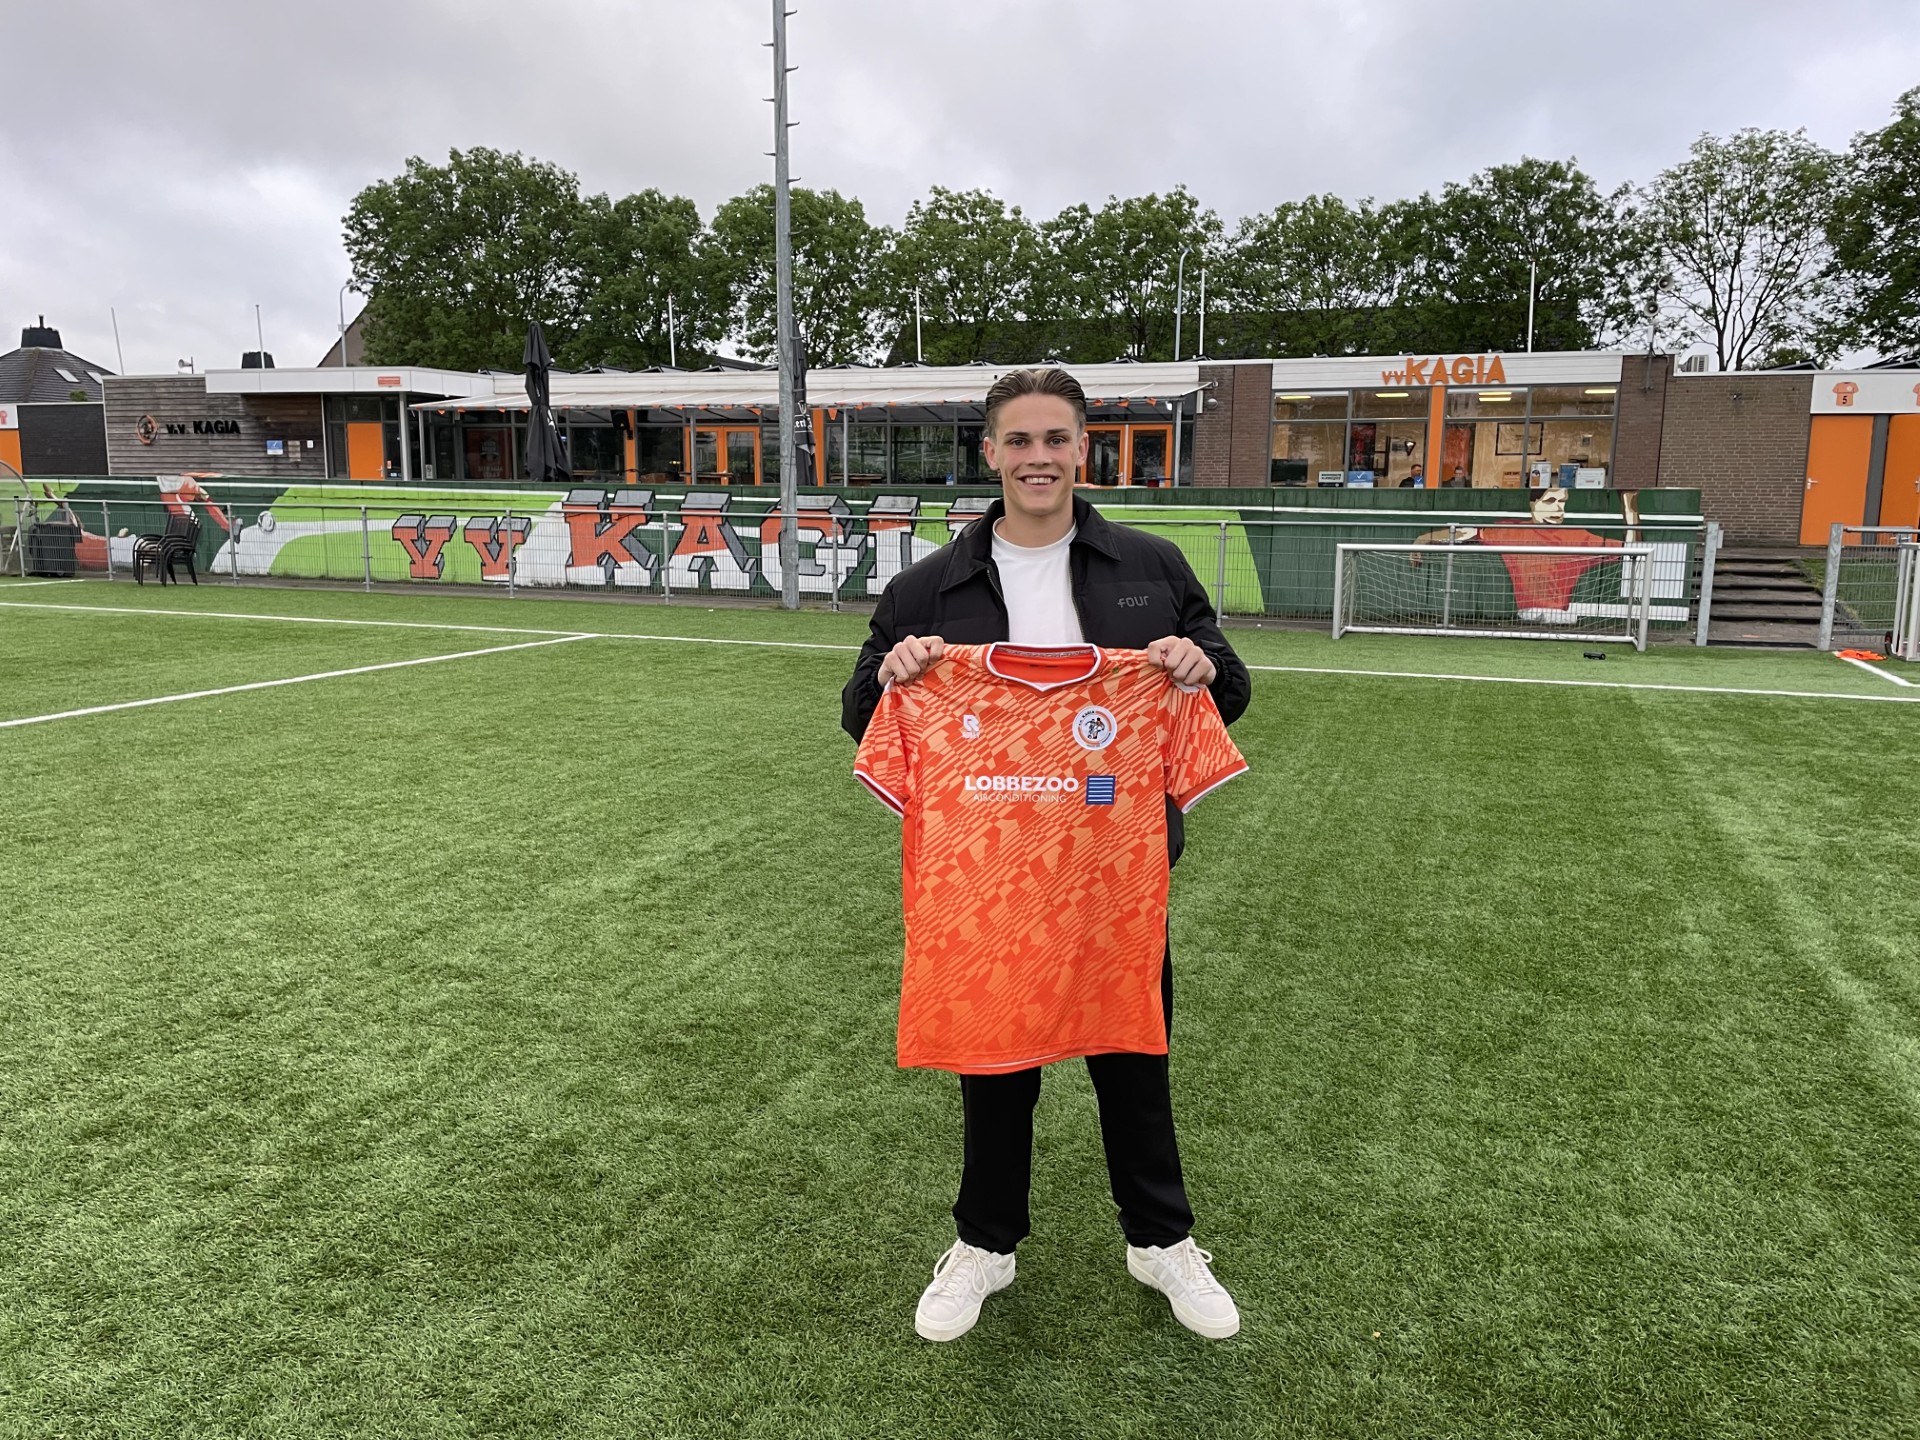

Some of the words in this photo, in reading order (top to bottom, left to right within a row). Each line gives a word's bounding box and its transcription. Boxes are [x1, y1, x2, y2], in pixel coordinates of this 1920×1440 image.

[1842, 395, 1848, 405] 5
[193, 420, 241, 434] KAGIA
[561, 487, 1001, 594] KAGI
[964, 775, 1079, 792] LOBBEZOO
[973, 793, 1067, 803] AIRCONDITIONING
